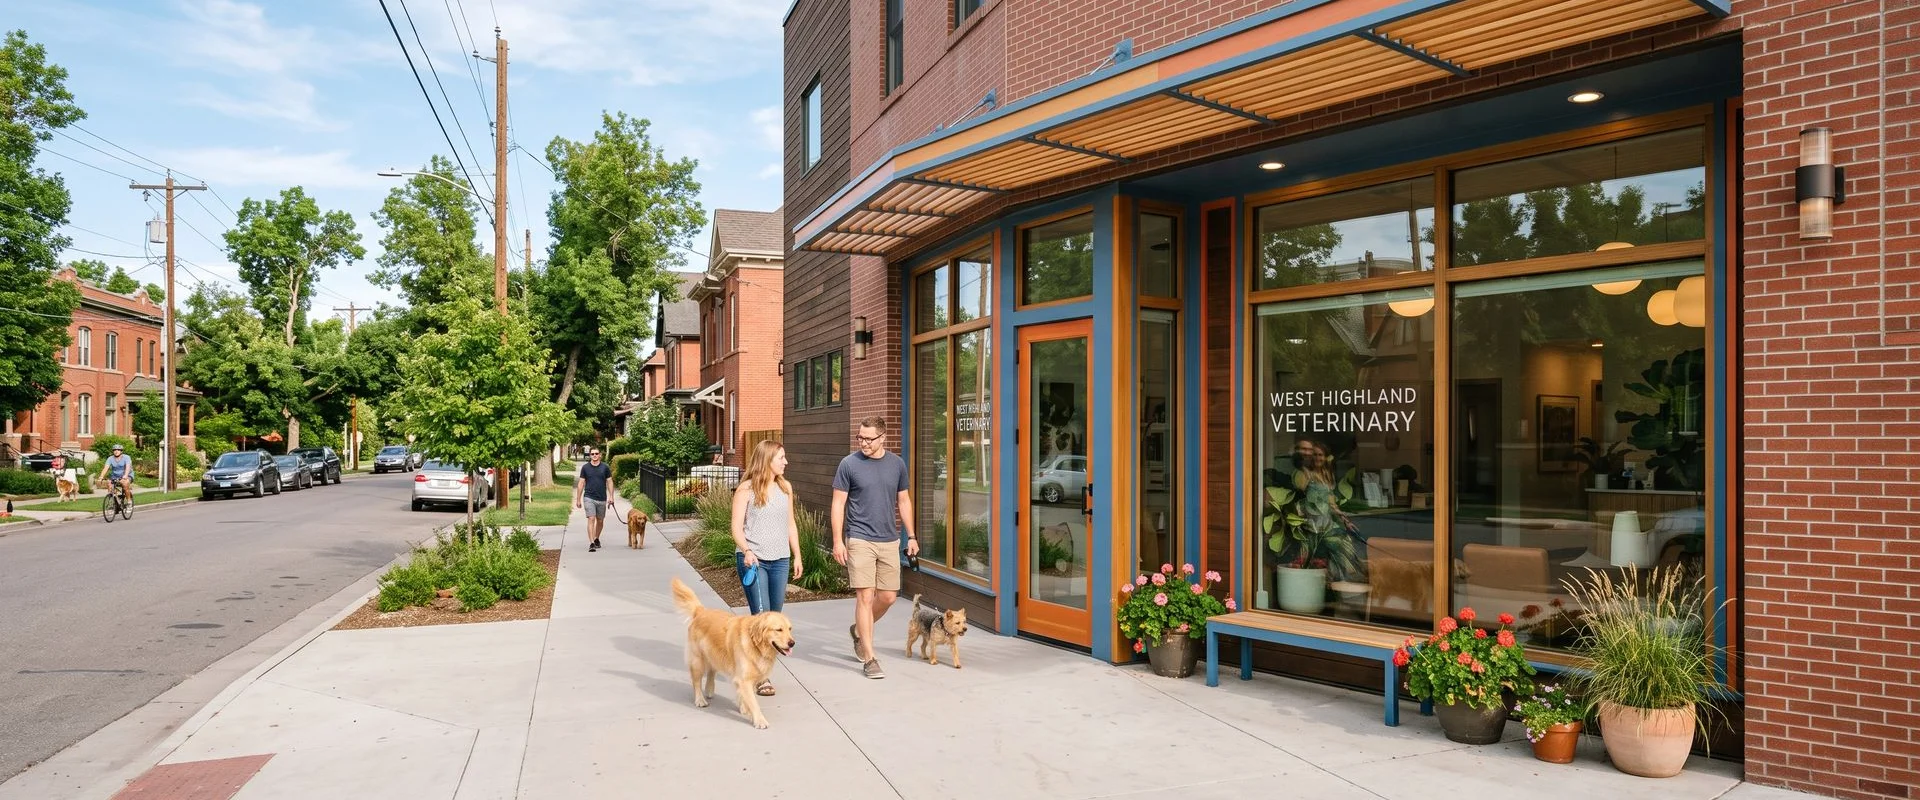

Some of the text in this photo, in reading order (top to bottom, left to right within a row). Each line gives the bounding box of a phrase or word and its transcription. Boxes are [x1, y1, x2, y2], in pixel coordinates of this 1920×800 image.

[1270, 387, 1416, 407] WEST HIGHLAND
[1270, 411, 1416, 432] VETERINARY
